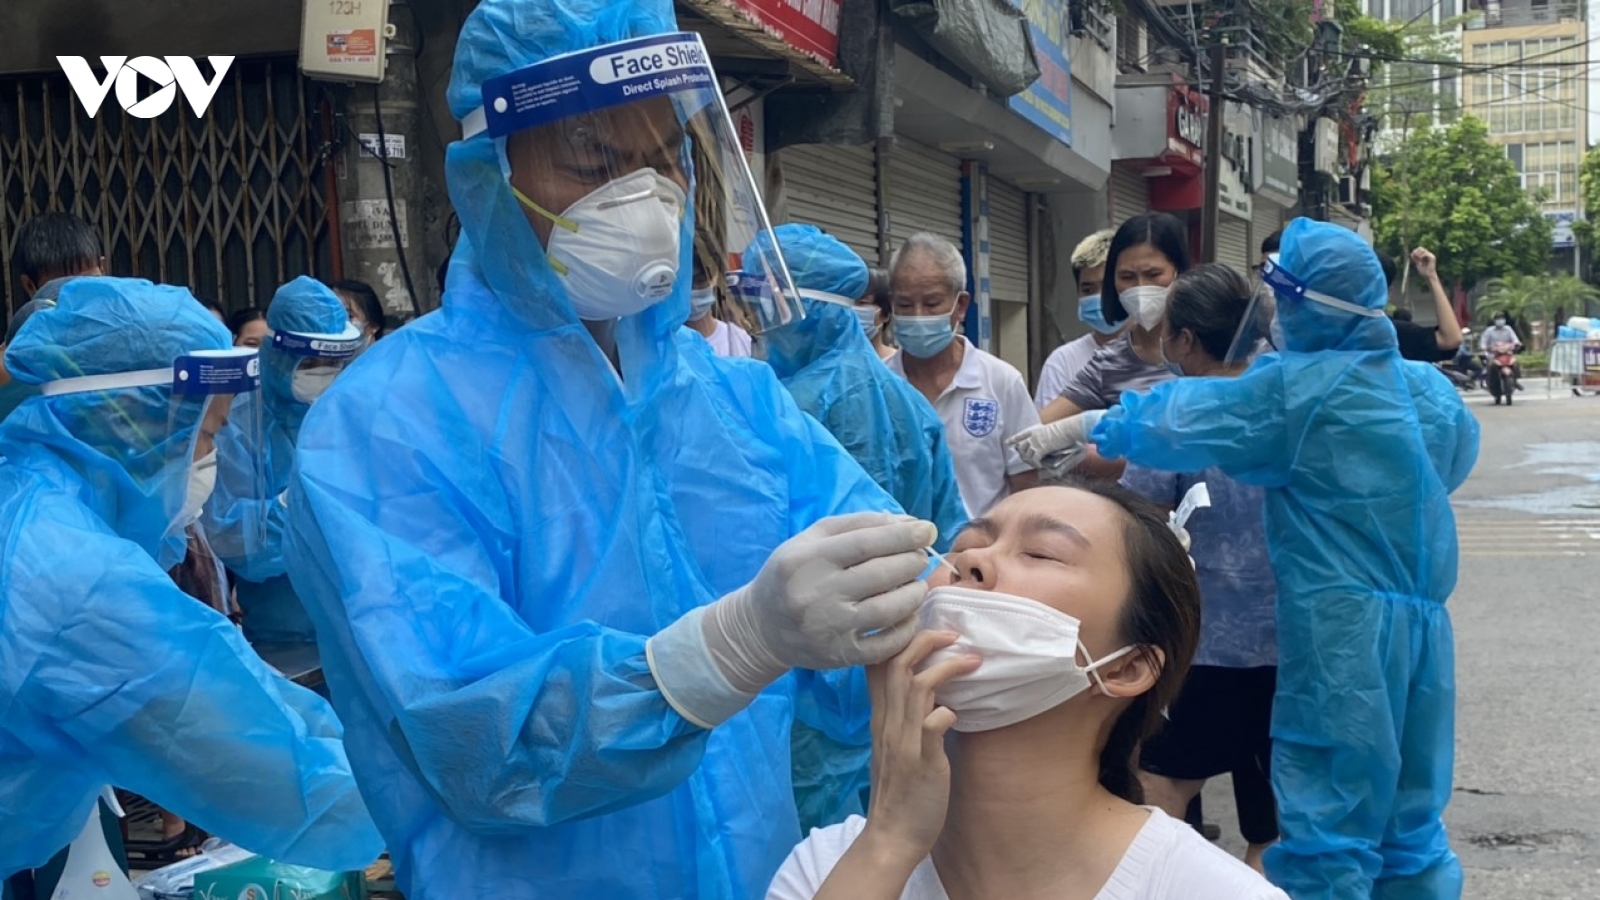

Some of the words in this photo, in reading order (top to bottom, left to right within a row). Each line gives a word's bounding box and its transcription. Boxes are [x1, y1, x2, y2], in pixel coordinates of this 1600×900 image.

[610, 53, 664, 78] Face
[622, 82, 653, 96] Direct
[653, 76, 682, 90] Splash
